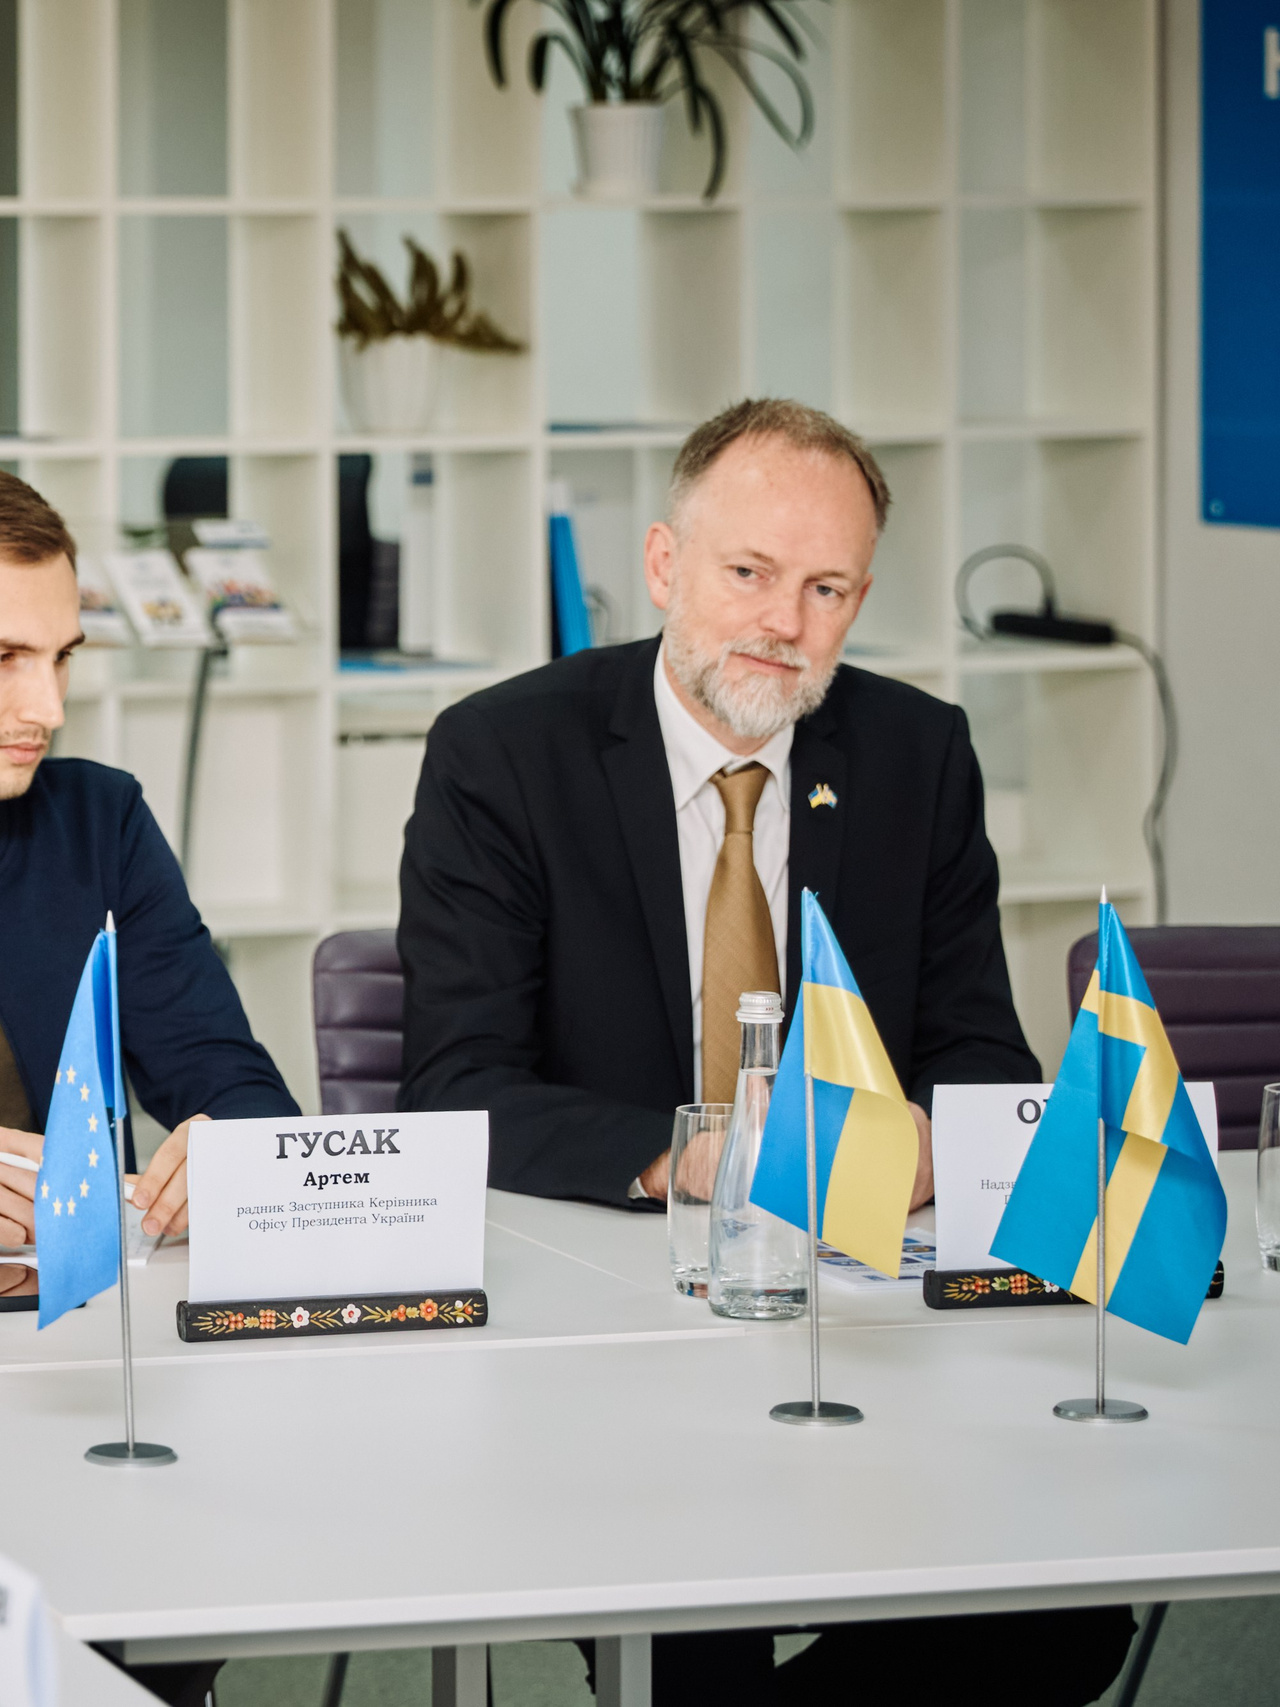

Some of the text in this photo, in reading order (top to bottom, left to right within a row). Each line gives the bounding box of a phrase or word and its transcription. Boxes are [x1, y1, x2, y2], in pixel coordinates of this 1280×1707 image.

[275, 1128, 401, 1159] ГУСАК
[302, 1171, 370, 1190] Артем
[237, 1197, 438, 1217] радник Заступника Керівника
[248, 1213, 425, 1232] Офісу Президента України
